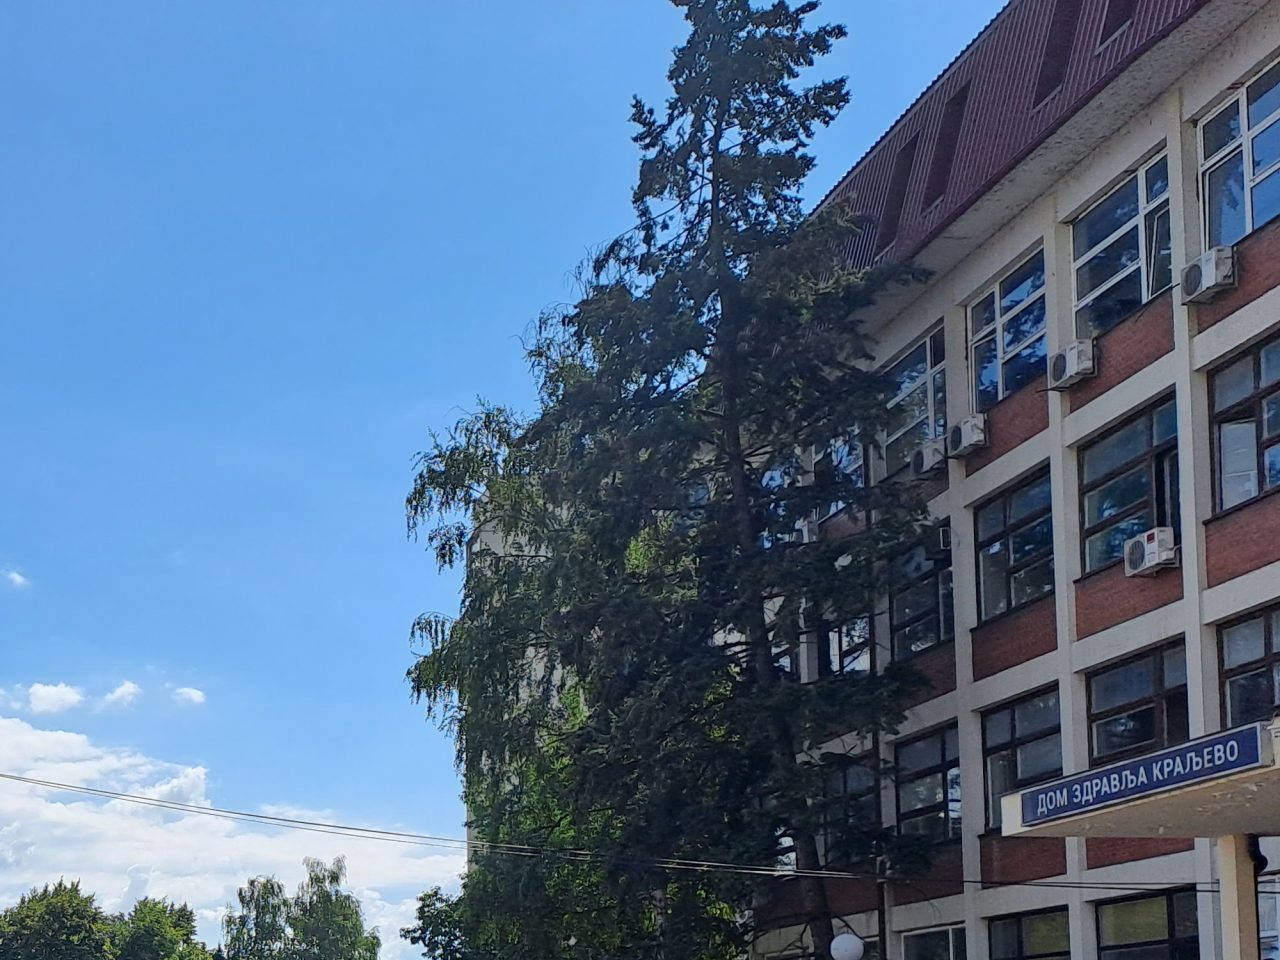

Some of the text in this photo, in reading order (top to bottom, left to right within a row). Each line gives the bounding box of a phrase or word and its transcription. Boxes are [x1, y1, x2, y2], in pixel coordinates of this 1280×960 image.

[1037, 740, 1239, 816] ДОМ ЗДРАВЉА КРАЉЕВО
